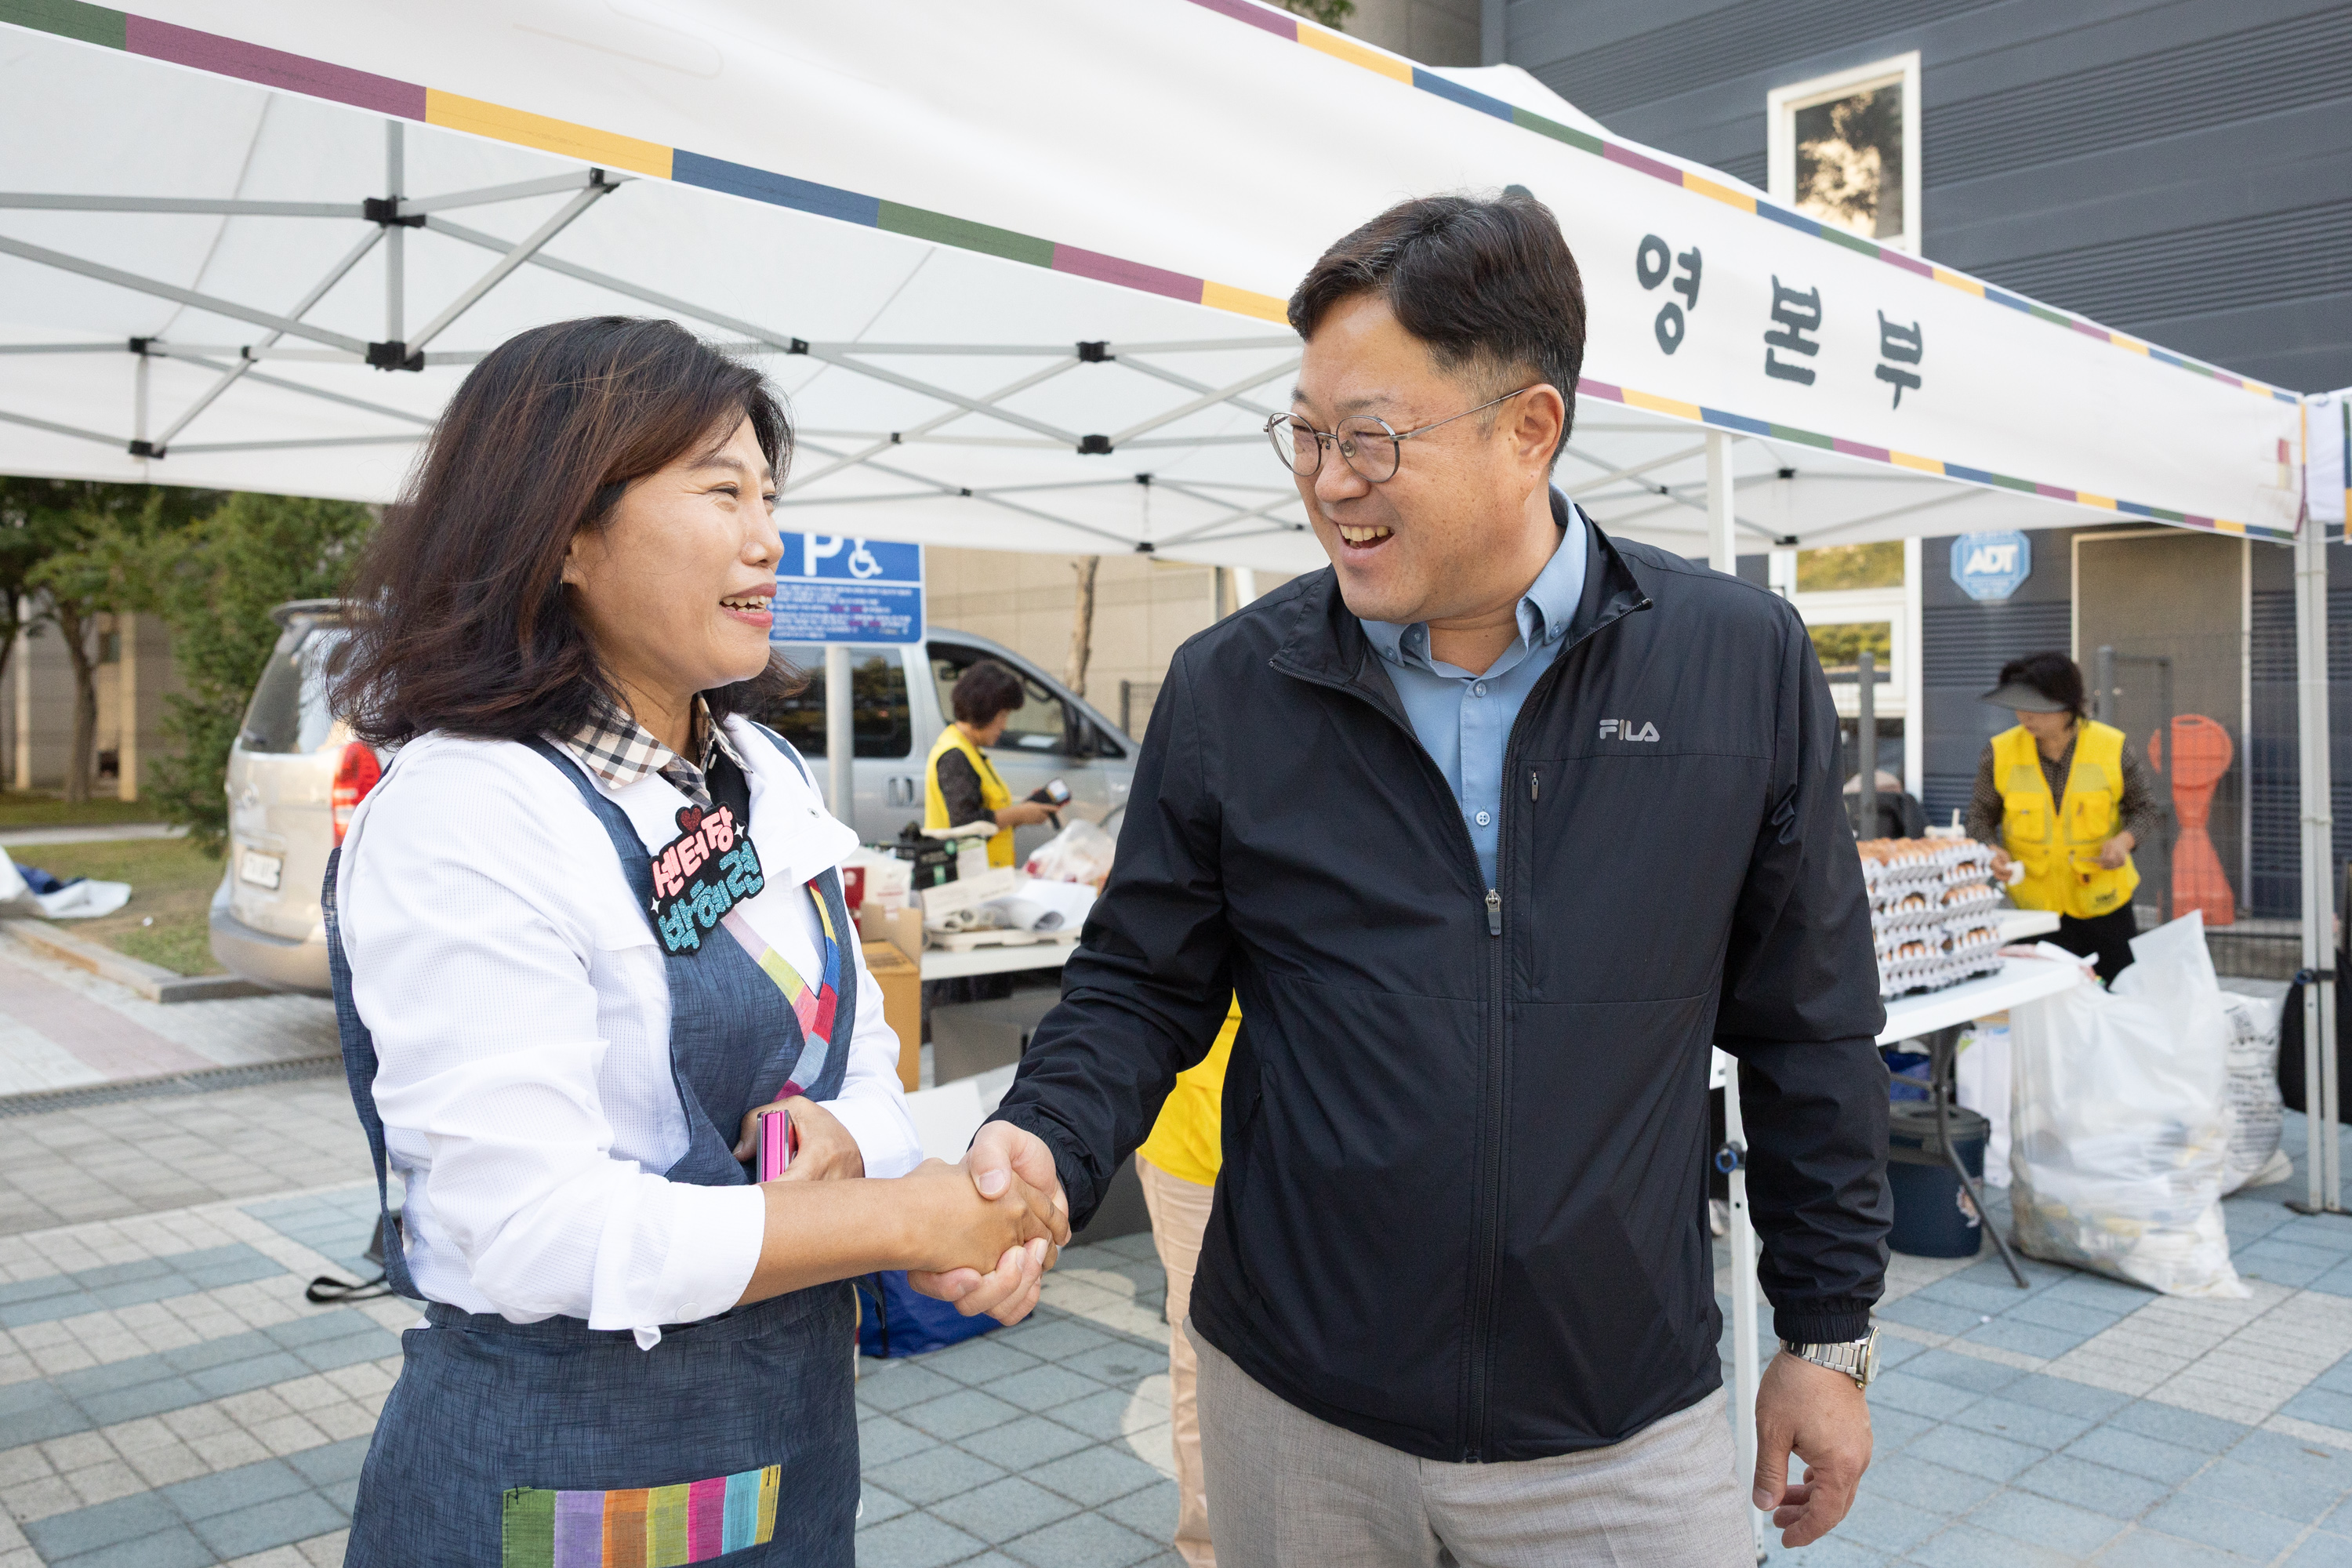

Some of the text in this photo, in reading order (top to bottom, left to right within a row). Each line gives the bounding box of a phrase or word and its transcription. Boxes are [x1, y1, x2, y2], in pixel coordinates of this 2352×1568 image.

[1964, 544, 2019, 574] ADT
[1599, 719, 1660, 742] FILA
[652, 806, 735, 898] 센터장
[658, 840, 764, 952] 박혜련
